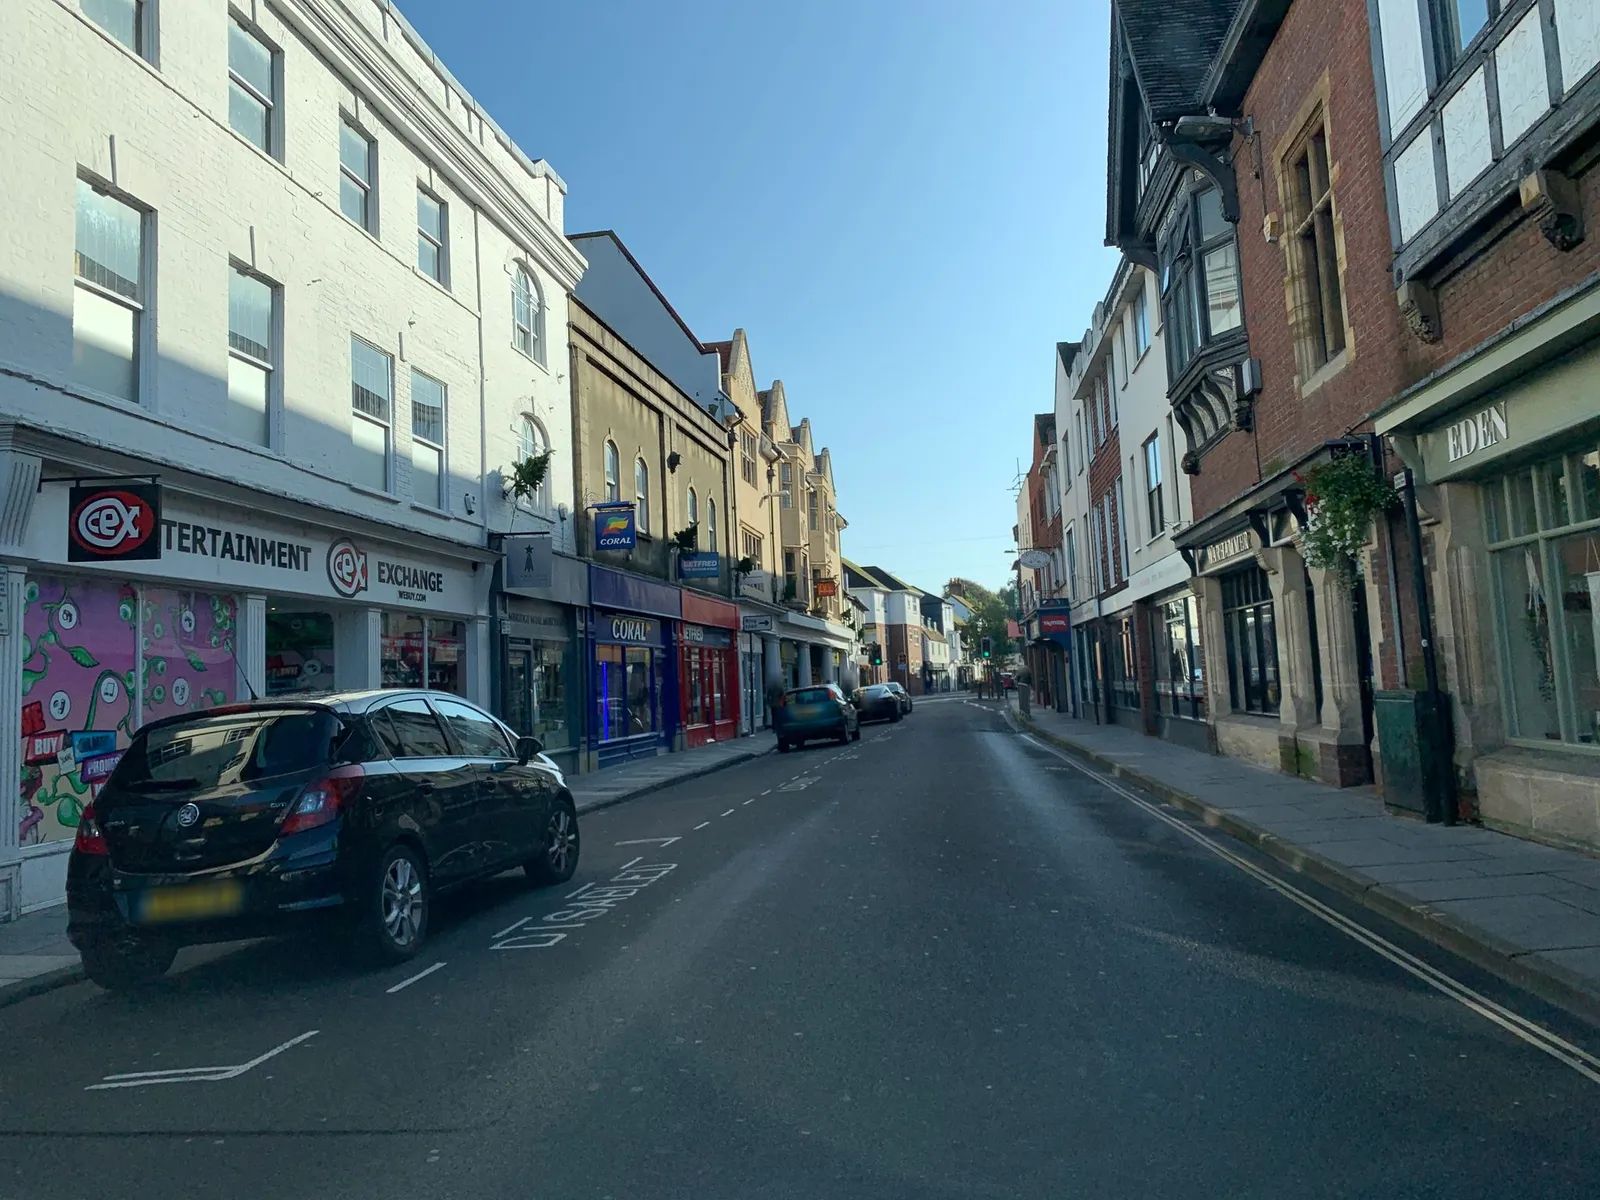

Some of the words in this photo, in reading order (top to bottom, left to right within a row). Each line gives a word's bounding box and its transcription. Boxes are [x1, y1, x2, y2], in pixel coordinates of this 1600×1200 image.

[1446, 401, 1509, 463] EDEN
[161, 517, 312, 572] TERTAINMENT
[600, 537, 632, 546] CORAL
[1207, 531, 1249, 564] WARHAMMER
[377, 561, 443, 593] EXCHANGE
[398, 590, 427, 602] WEBUY.COM
[612, 619, 646, 641] CORAL
[34, 737, 58, 755] BUY
[489, 862, 678, 950] DISABLED
